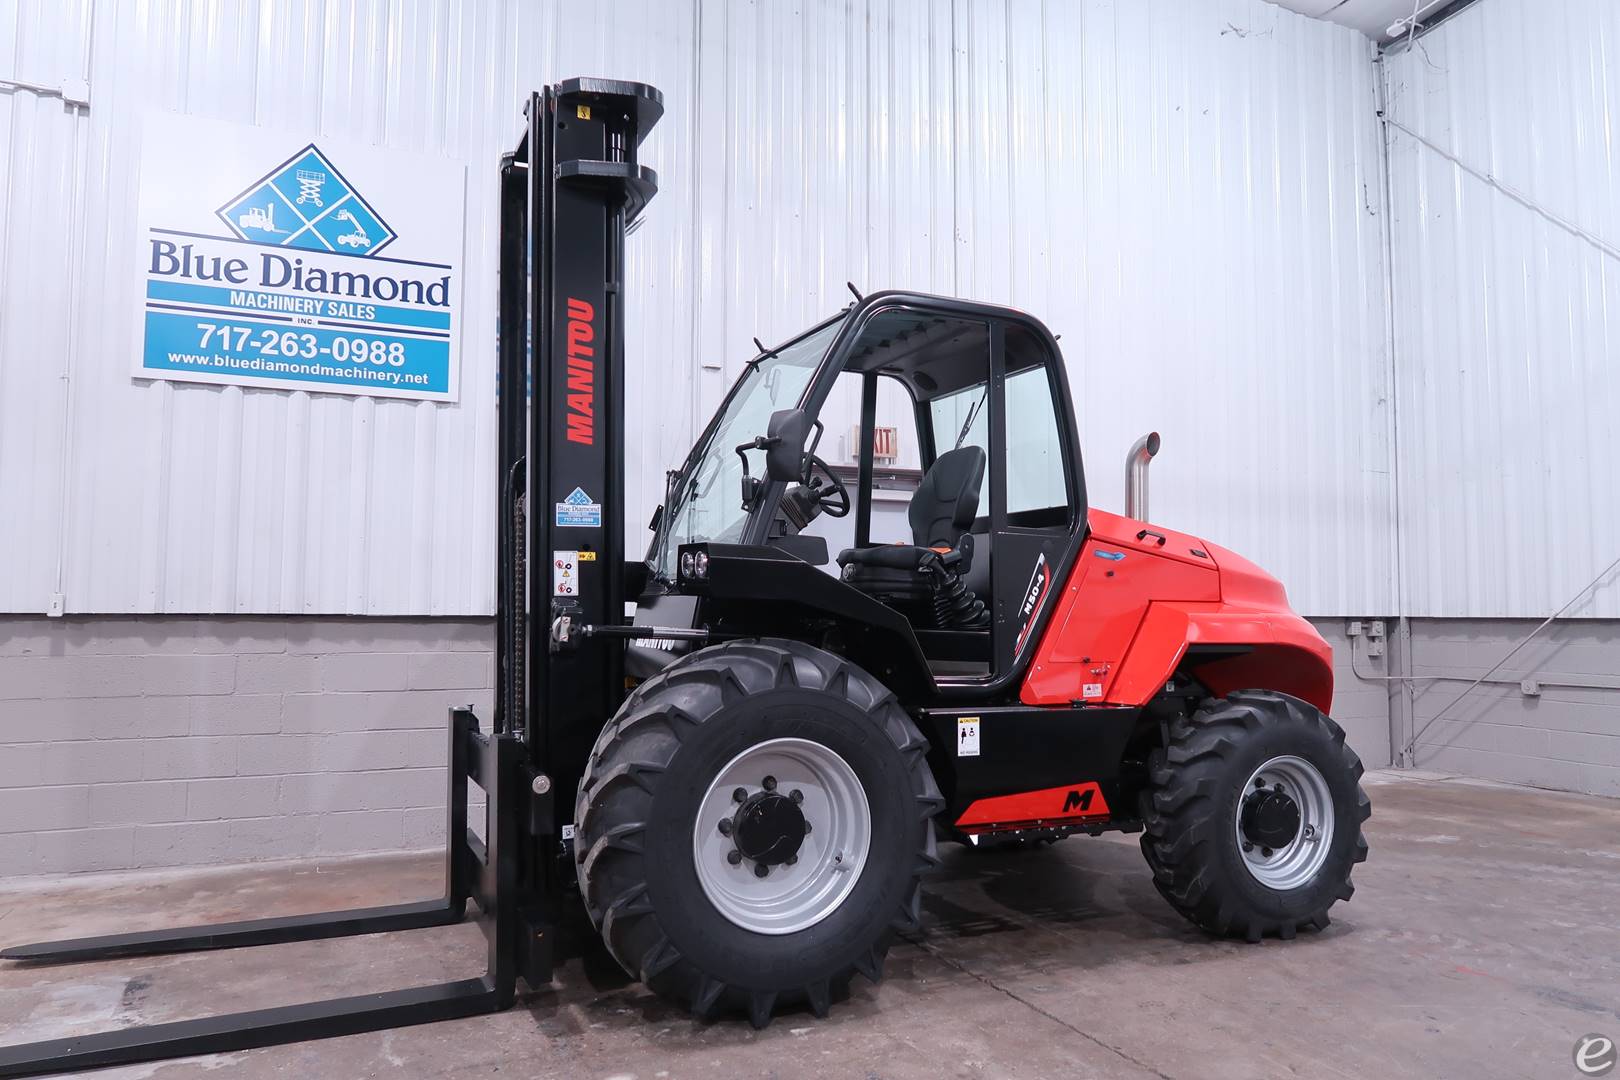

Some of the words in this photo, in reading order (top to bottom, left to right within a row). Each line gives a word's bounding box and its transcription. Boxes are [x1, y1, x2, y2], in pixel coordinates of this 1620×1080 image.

[148, 239, 248, 285] Blue
[259, 252, 451, 307] Diamond
[230, 290, 323, 314] MACHINERY
[328, 302, 376, 320] SALES
[196, 323, 405, 367] 717-263-0988
[168, 352, 429, 385] www.bluediamondmachinery.net
[567, 298, 594, 445] MANITOU
[1024, 573, 1045, 615] M50-4
[1063, 790, 1095, 812] M
